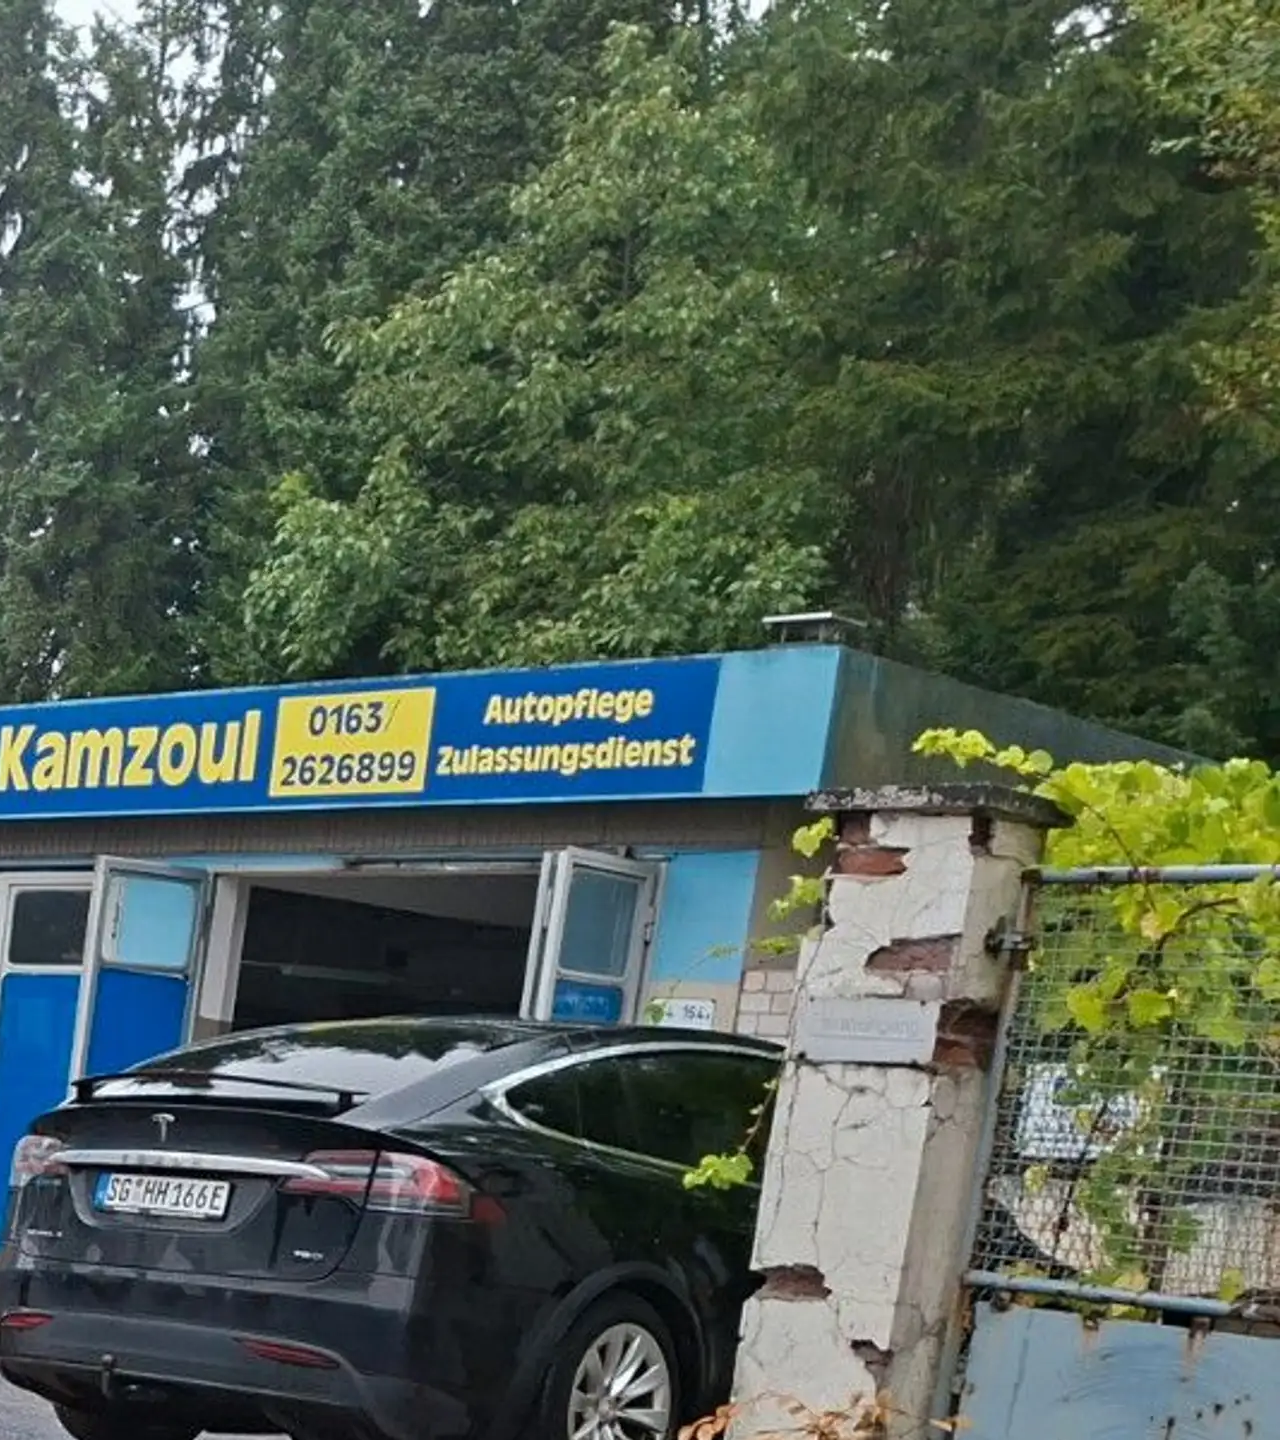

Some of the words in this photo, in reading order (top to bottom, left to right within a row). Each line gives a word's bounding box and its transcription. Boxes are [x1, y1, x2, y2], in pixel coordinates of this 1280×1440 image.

[484, 687, 654, 729] Autopflege
[280, 750, 416, 787] 2626899
[436, 733, 696, 781] Zulassungsdienst
[107, 1178, 131, 1202] SG
